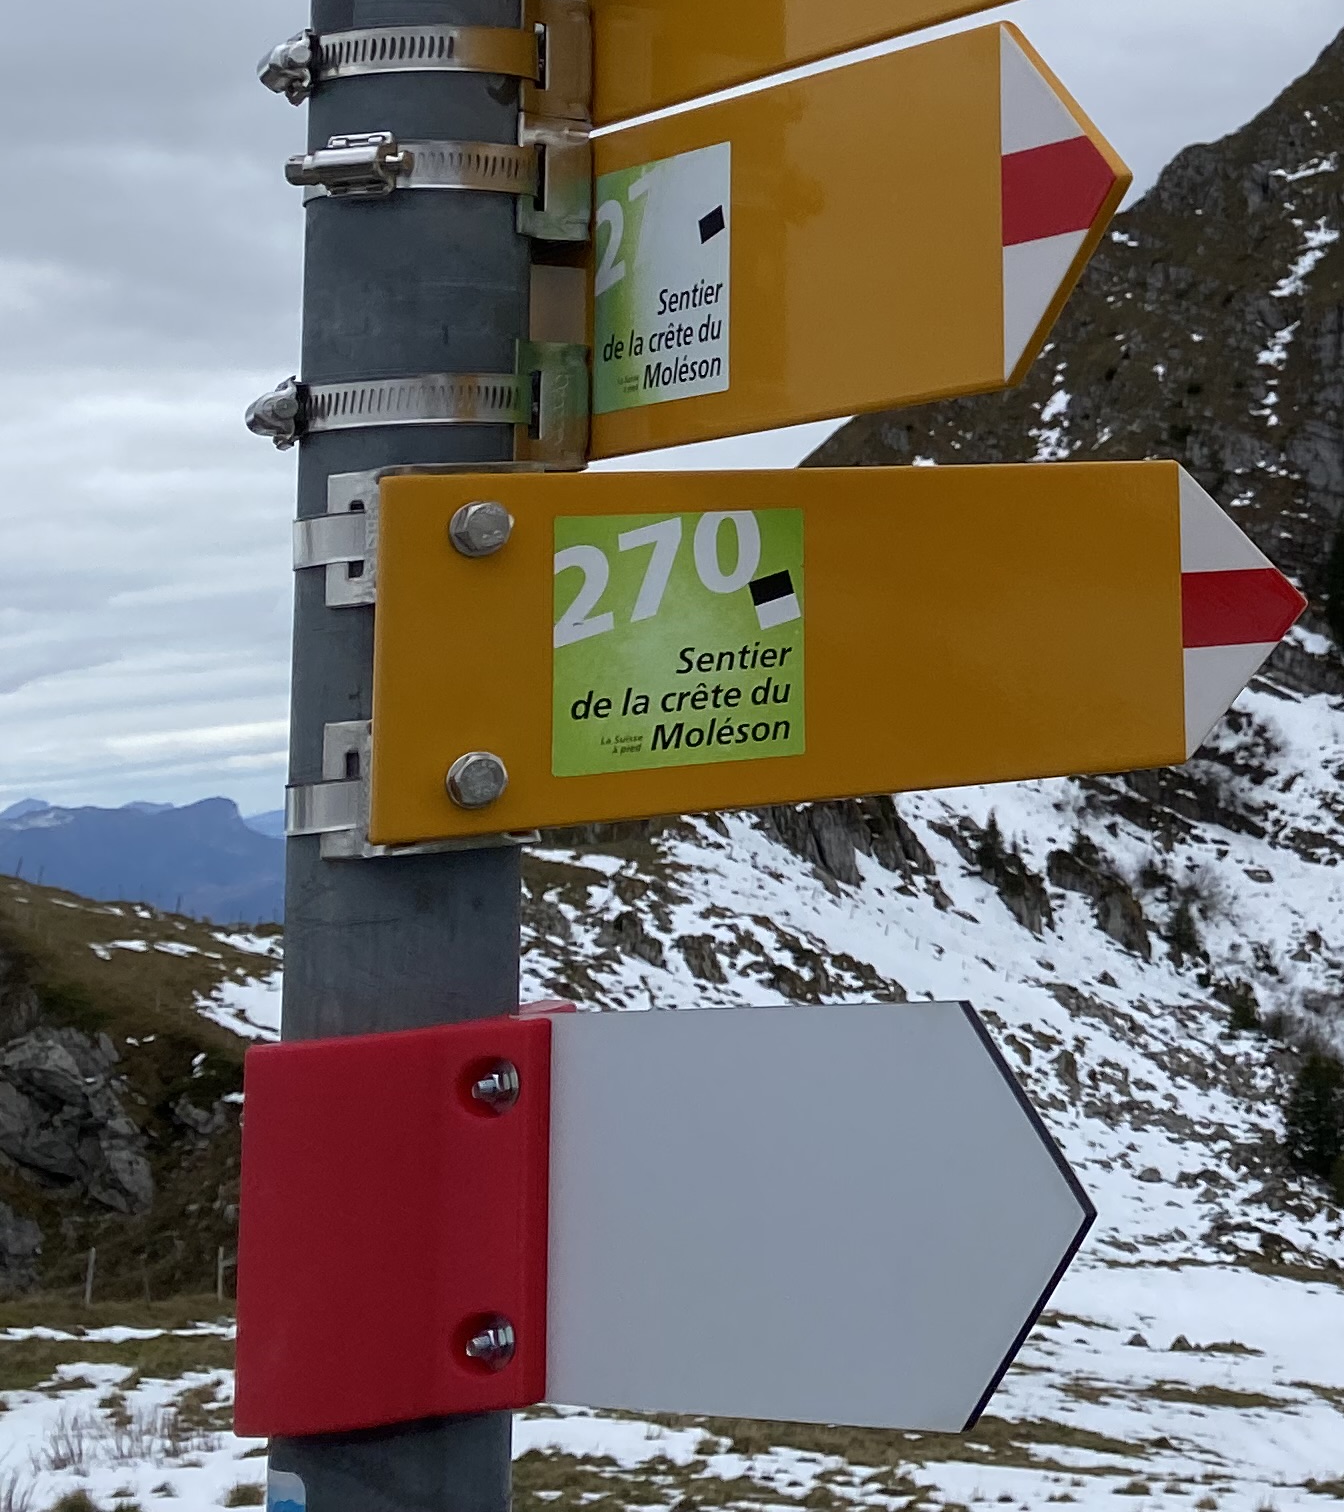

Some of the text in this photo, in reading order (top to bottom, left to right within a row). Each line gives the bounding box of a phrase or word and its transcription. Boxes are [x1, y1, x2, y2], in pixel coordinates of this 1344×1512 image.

[657, 279, 723, 316] Sentier
[602, 313, 722, 363] de la crête du
[643, 355, 721, 390] Moléson
[553, 509, 762, 649] 270
[675, 641, 793, 674] Sentier
[571, 676, 791, 721] de la crête du
[650, 717, 791, 751] Moléson
